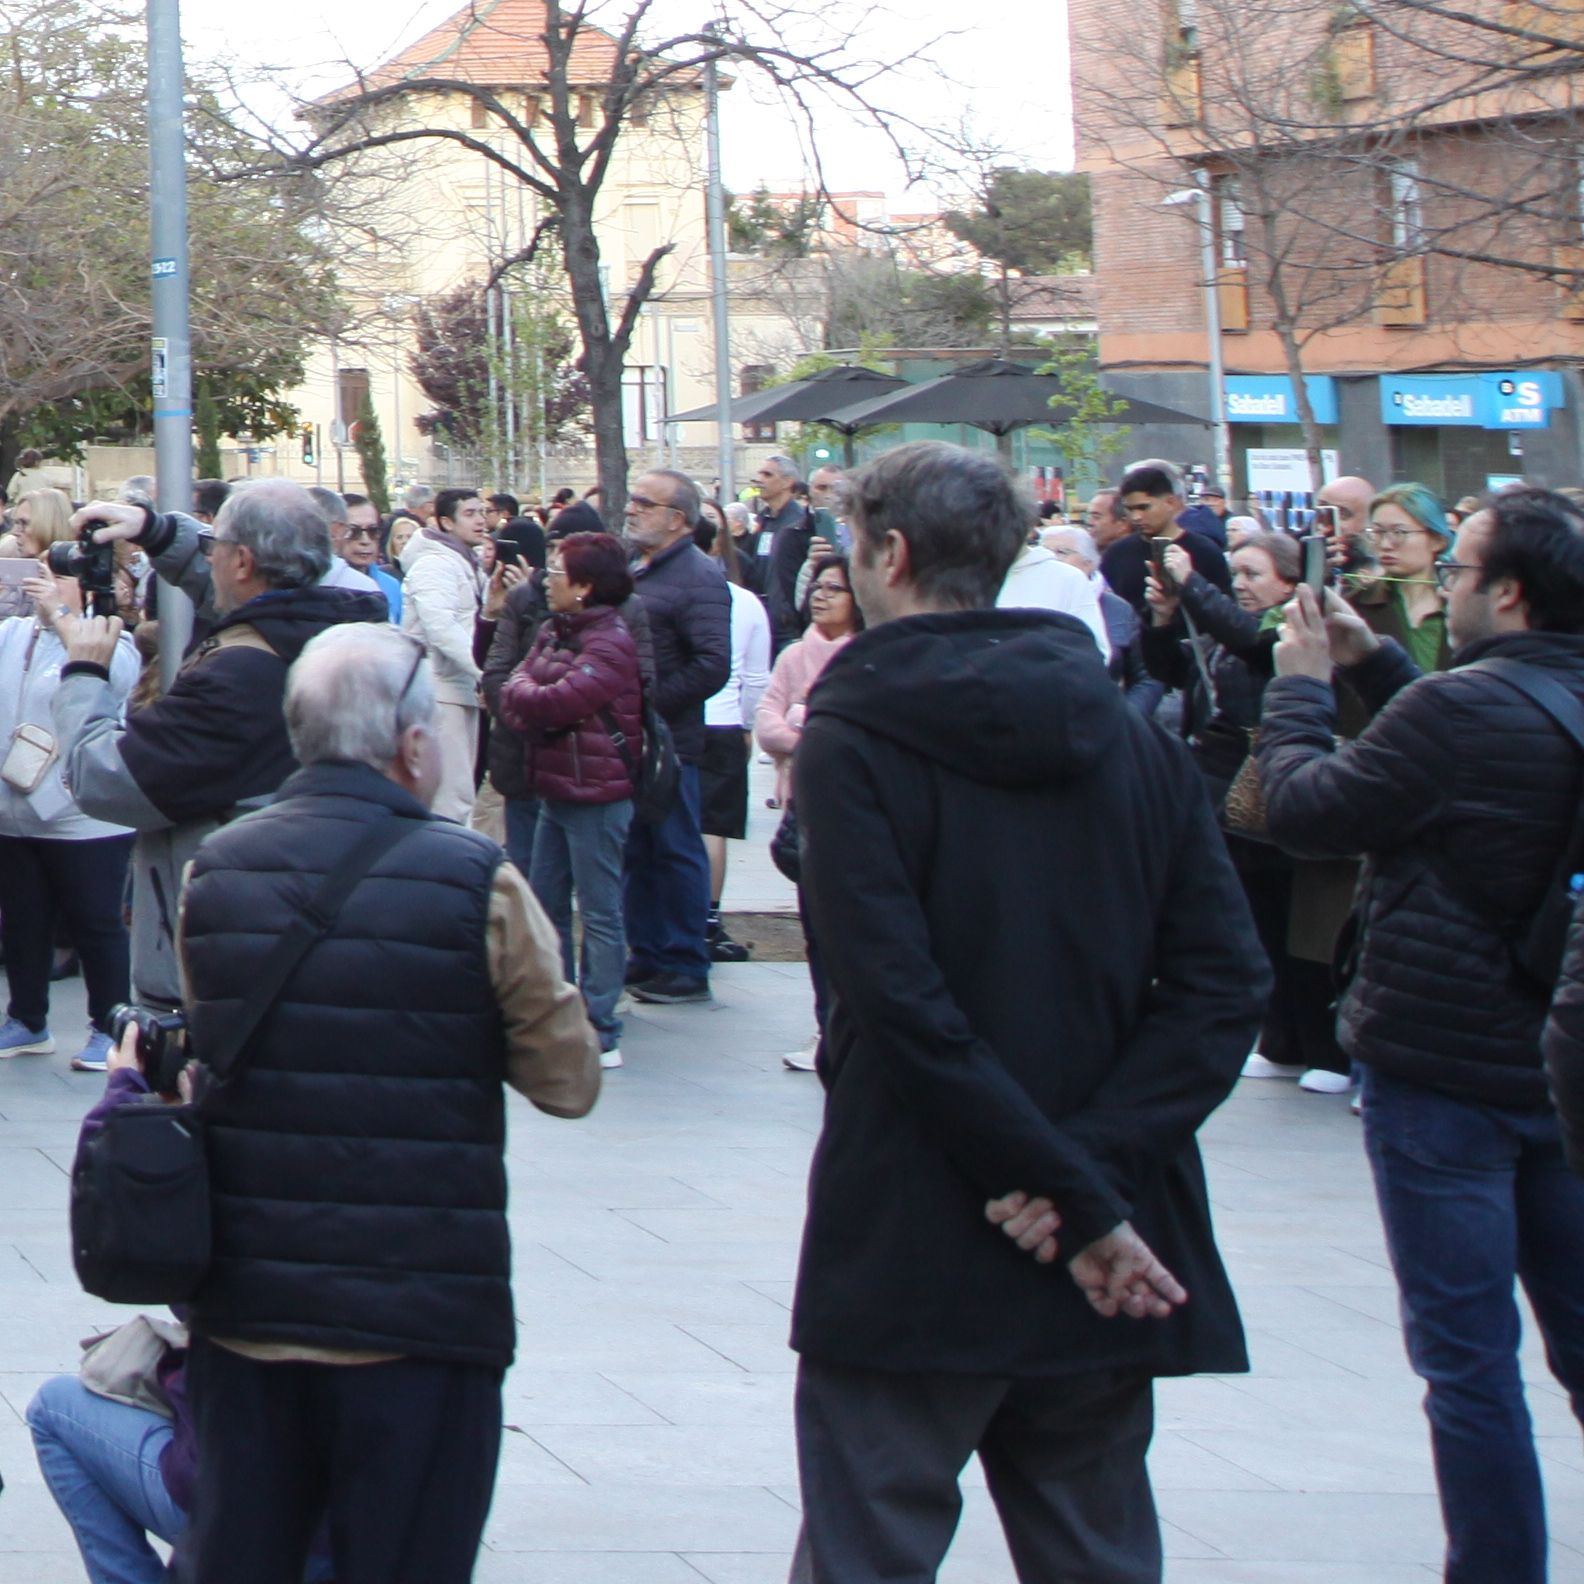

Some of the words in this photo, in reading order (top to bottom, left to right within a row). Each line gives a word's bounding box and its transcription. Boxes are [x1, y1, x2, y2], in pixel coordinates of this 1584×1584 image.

[1228, 393, 1286, 415] Sabadell
[1403, 394, 1472, 417] Sabadell
[1500, 408, 1543, 423] ATM
